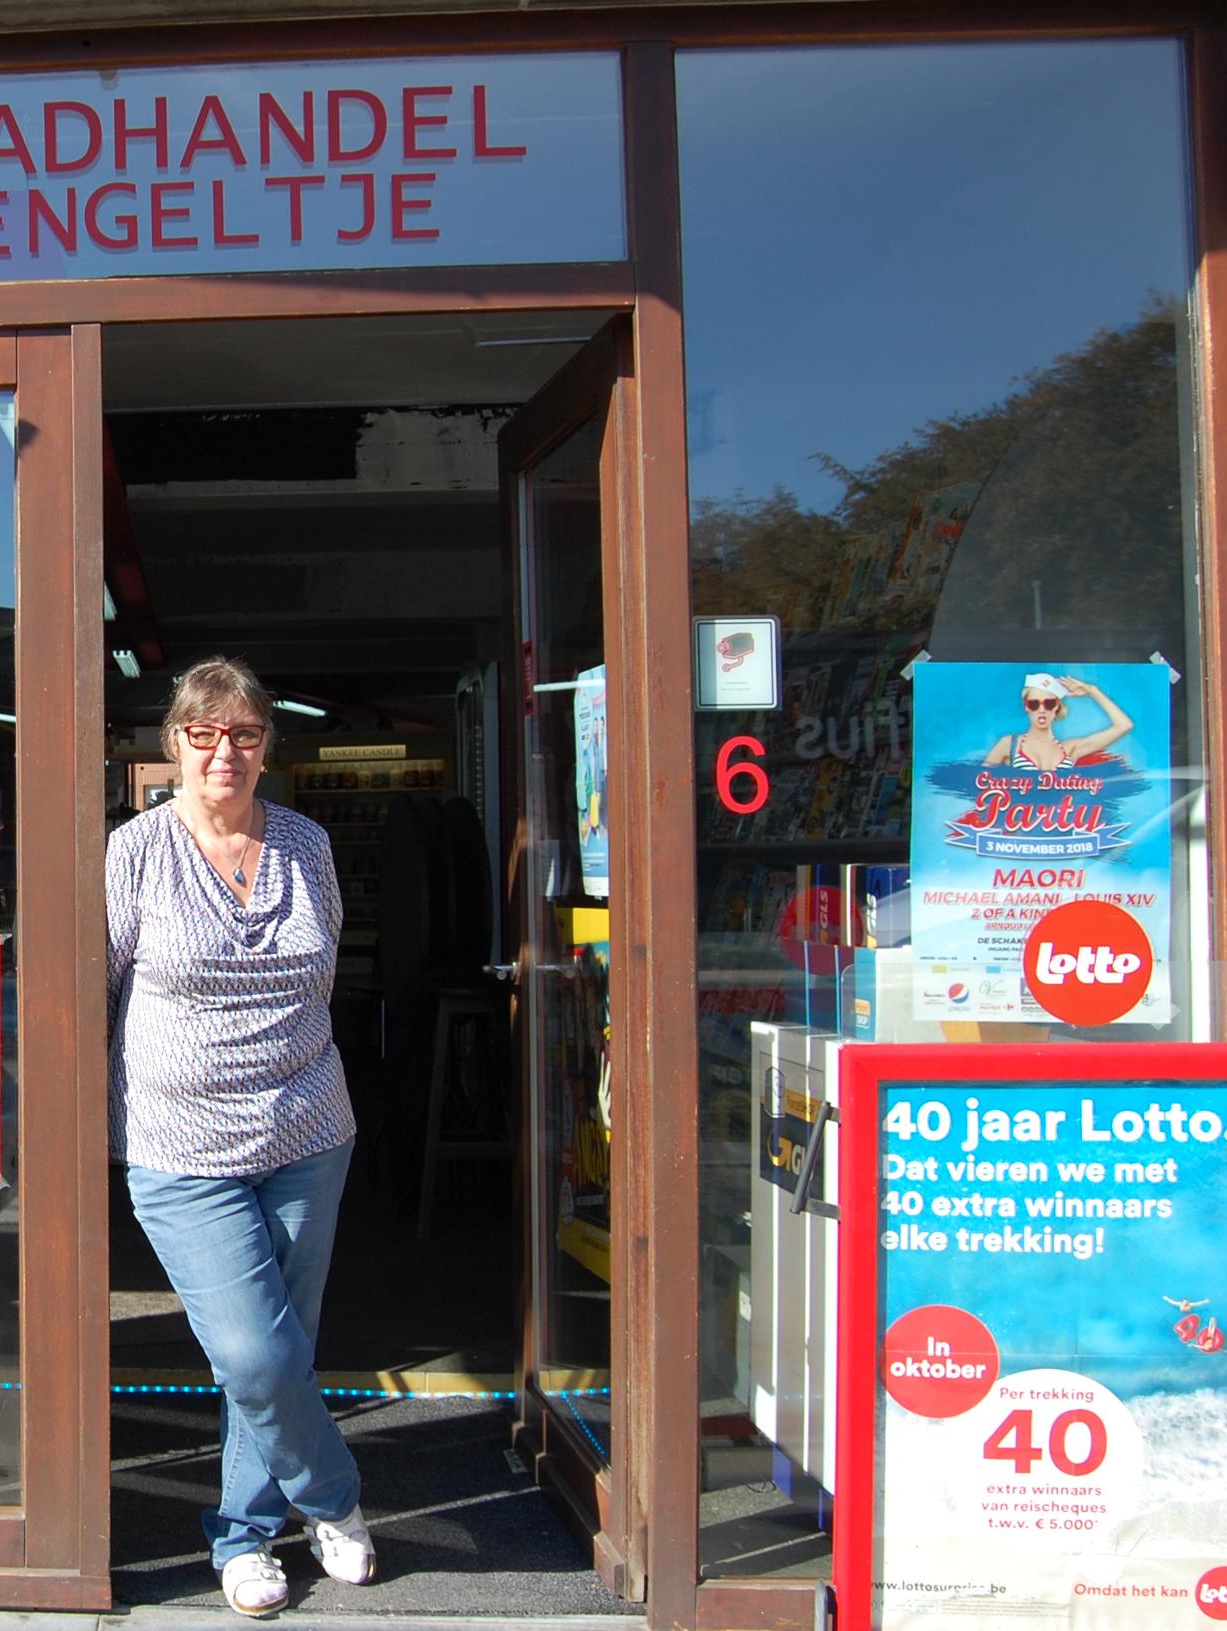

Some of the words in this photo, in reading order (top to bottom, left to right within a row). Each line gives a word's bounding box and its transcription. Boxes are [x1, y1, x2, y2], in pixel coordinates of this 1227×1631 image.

[323, 748, 359, 758] YANKEE
[362, 747, 401, 757] CANDLE
[716, 736, 769, 814] 6
[975, 771, 1033, 795] Crazy
[1037, 771, 1103, 796] Dating
[964, 788, 1106, 832] Party
[986, 841, 994, 851] 3
[995, 843, 1066, 854] NOVEMBER
[1067, 842, 1094, 854] 2018
[992, 868, 1085, 890] MAORI
[820, 890, 829, 929] GLS
[922, 891, 999, 906] MICHAEL
[1004, 892, 1062, 906] AMANI
[1125, 893, 1156, 907] XIV
[971, 908, 981, 920] 2
[983, 908, 1004, 920] OF
[1005, 908, 1016, 920] A
[1019, 908, 1050, 919] KIN
[977, 937, 990, 945] DE
[881, 1099, 951, 1141] 40
[961, 1098, 1065, 1151] jaar
[882, 1154, 938, 1182] Dat
[947, 1155, 1048, 1182] vieren
[1058, 1162, 1105, 1182] we
[1114, 1157, 1177, 1183] met
[881, 1192, 923, 1216] 40
[931, 1194, 1016, 1217] extra
[1026, 1192, 1173, 1218] winnaars
[881, 1227, 948, 1251] elke
[956, 1227, 1105, 1260] trekking!
[927, 1336, 950, 1357] In
[890, 1359, 986, 1380] oktober
[1000, 1387, 1024, 1400] Per
[1029, 1387, 1094, 1403] trekking
[983, 1409, 1108, 1477] 40
[987, 1484, 1026, 1496] extra
[1032, 1484, 1102, 1496] winnaars
[981, 1502, 1009, 1513] van
[1014, 1501, 1106, 1516] reischeques
[988, 1517, 1029, 1530] t.w.v.
[1035, 1518, 1045, 1530] €
[1074, 1583, 1128, 1598] Omdat
[1132, 1584, 1156, 1598] het
[1161, 1584, 1189, 1599] kan
